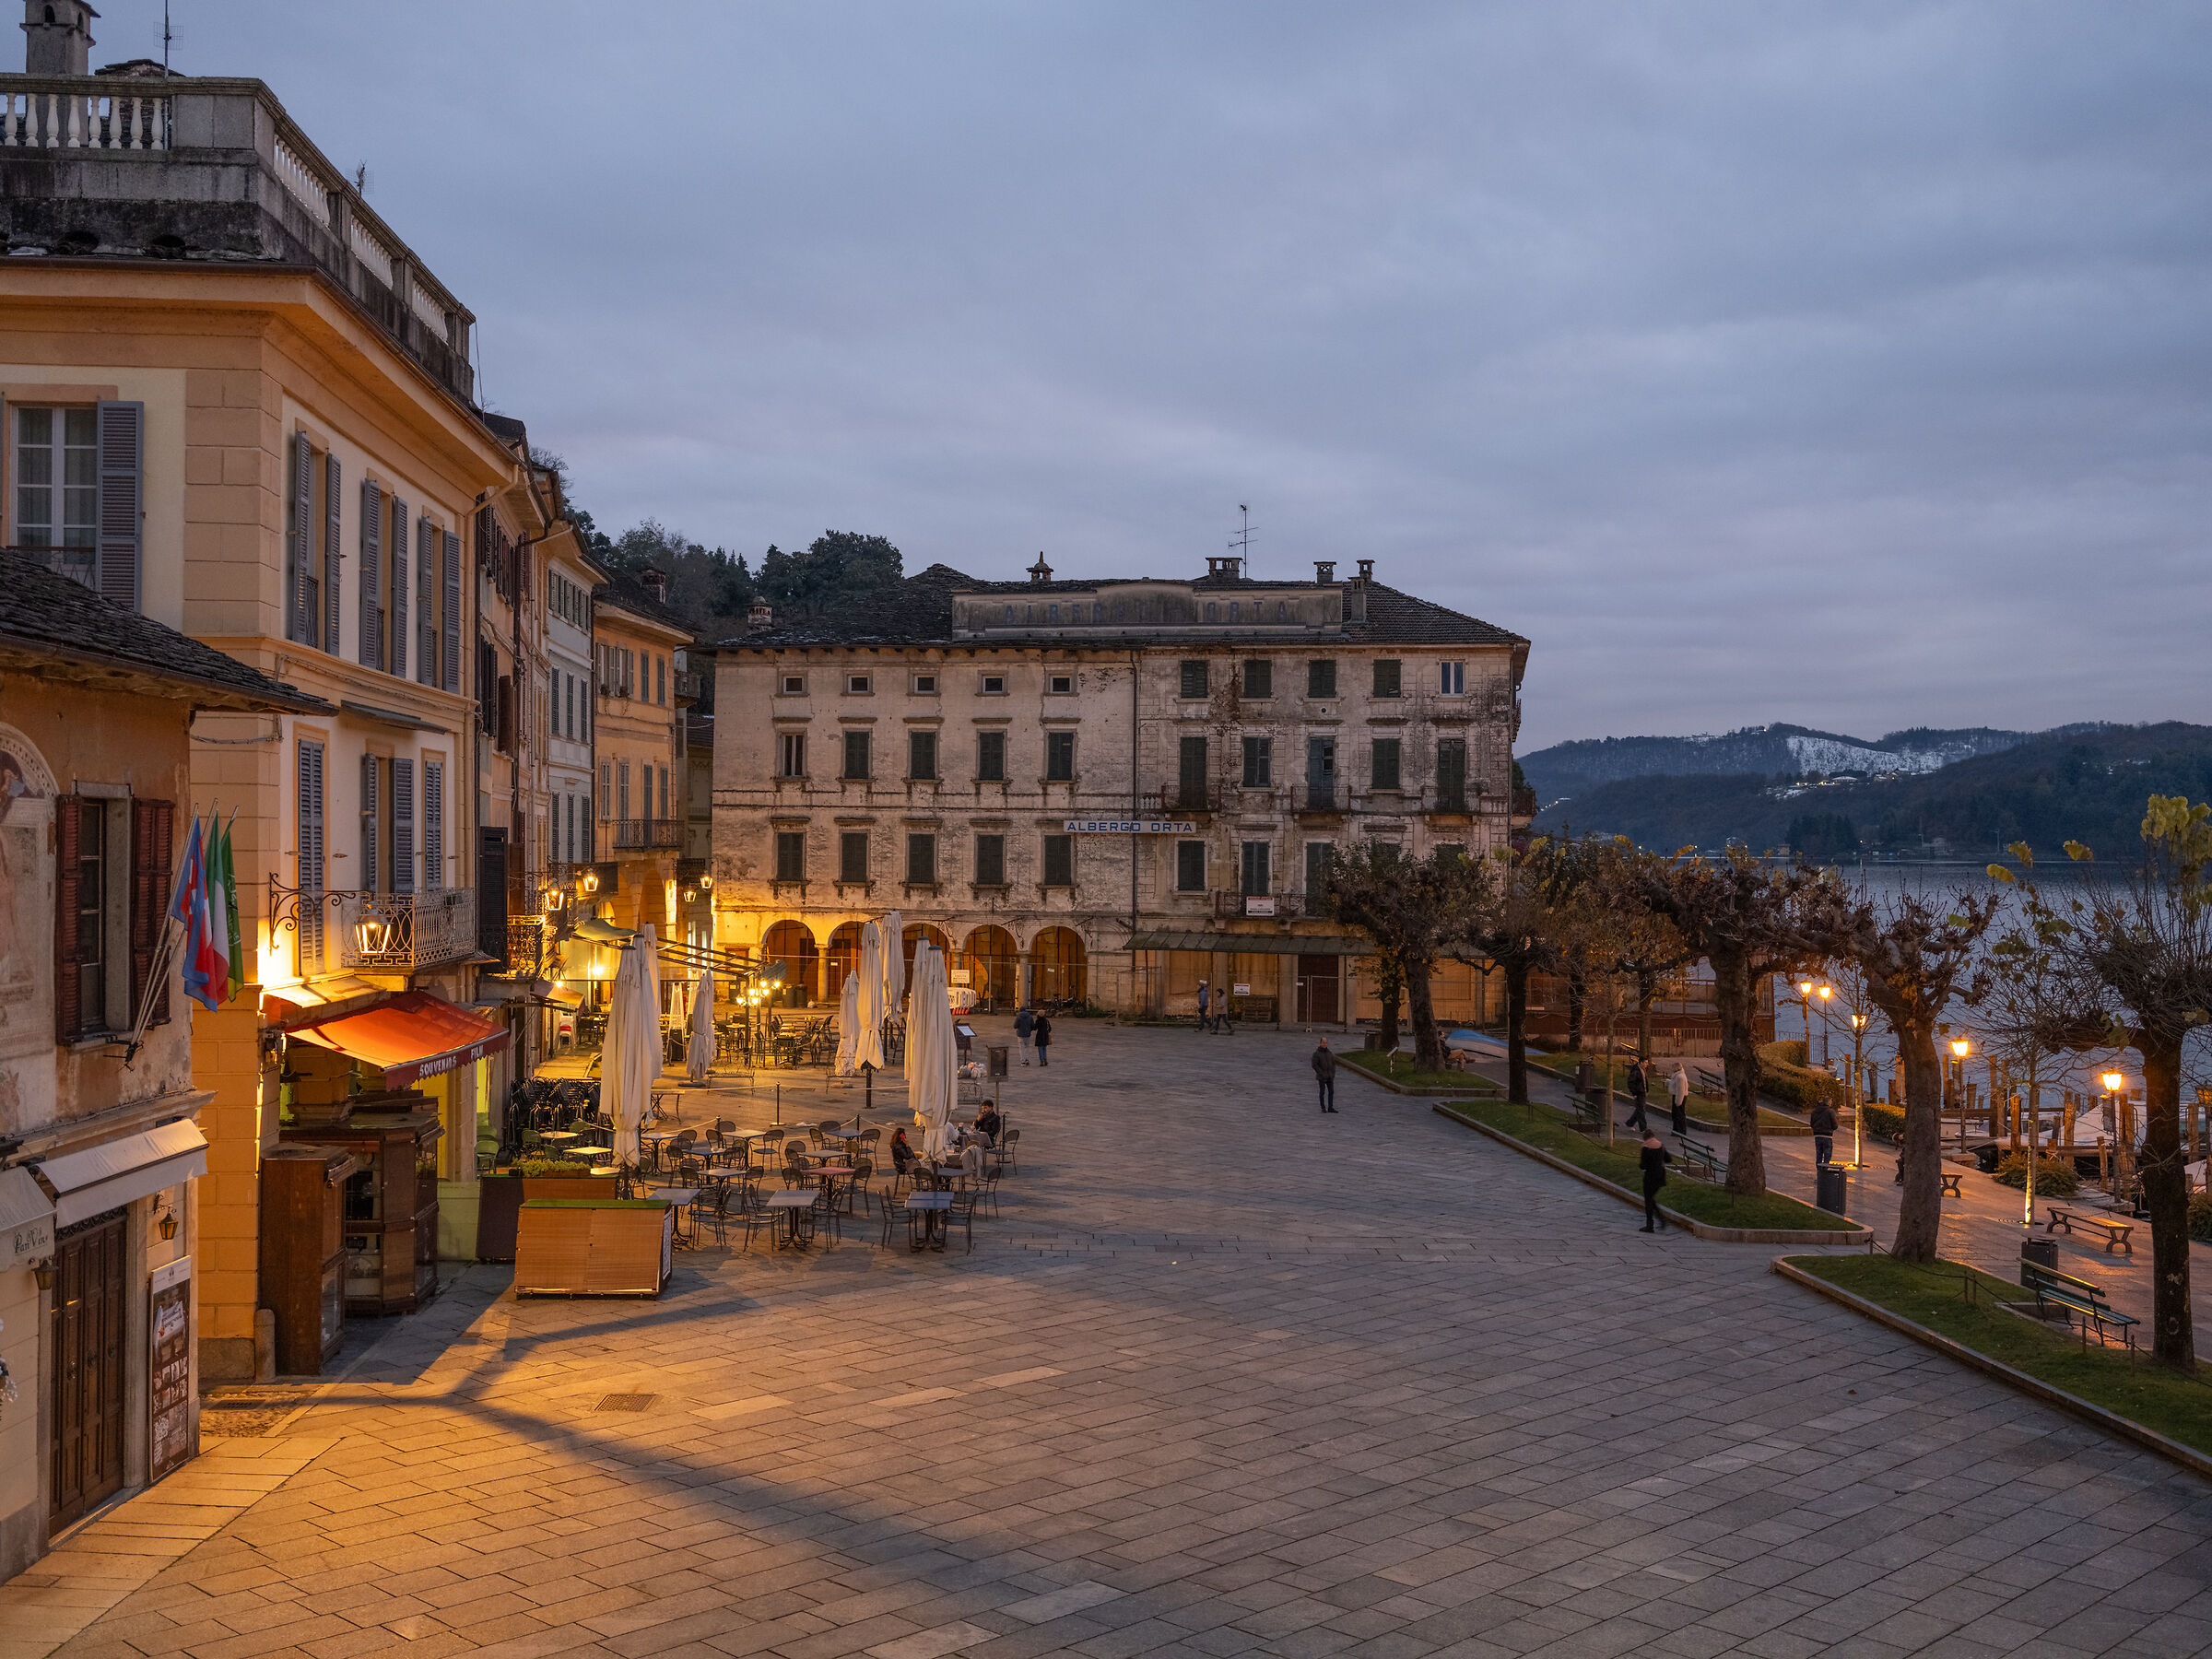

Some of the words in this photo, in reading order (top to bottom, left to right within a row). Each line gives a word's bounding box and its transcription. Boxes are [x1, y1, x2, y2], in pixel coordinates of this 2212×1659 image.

[1067, 821, 1141, 832] ALBERGO
[1150, 822, 1193, 832] ORTA
[419, 1055, 457, 1077] SOUVENIRS
[470, 1044, 484, 1060] FILM
